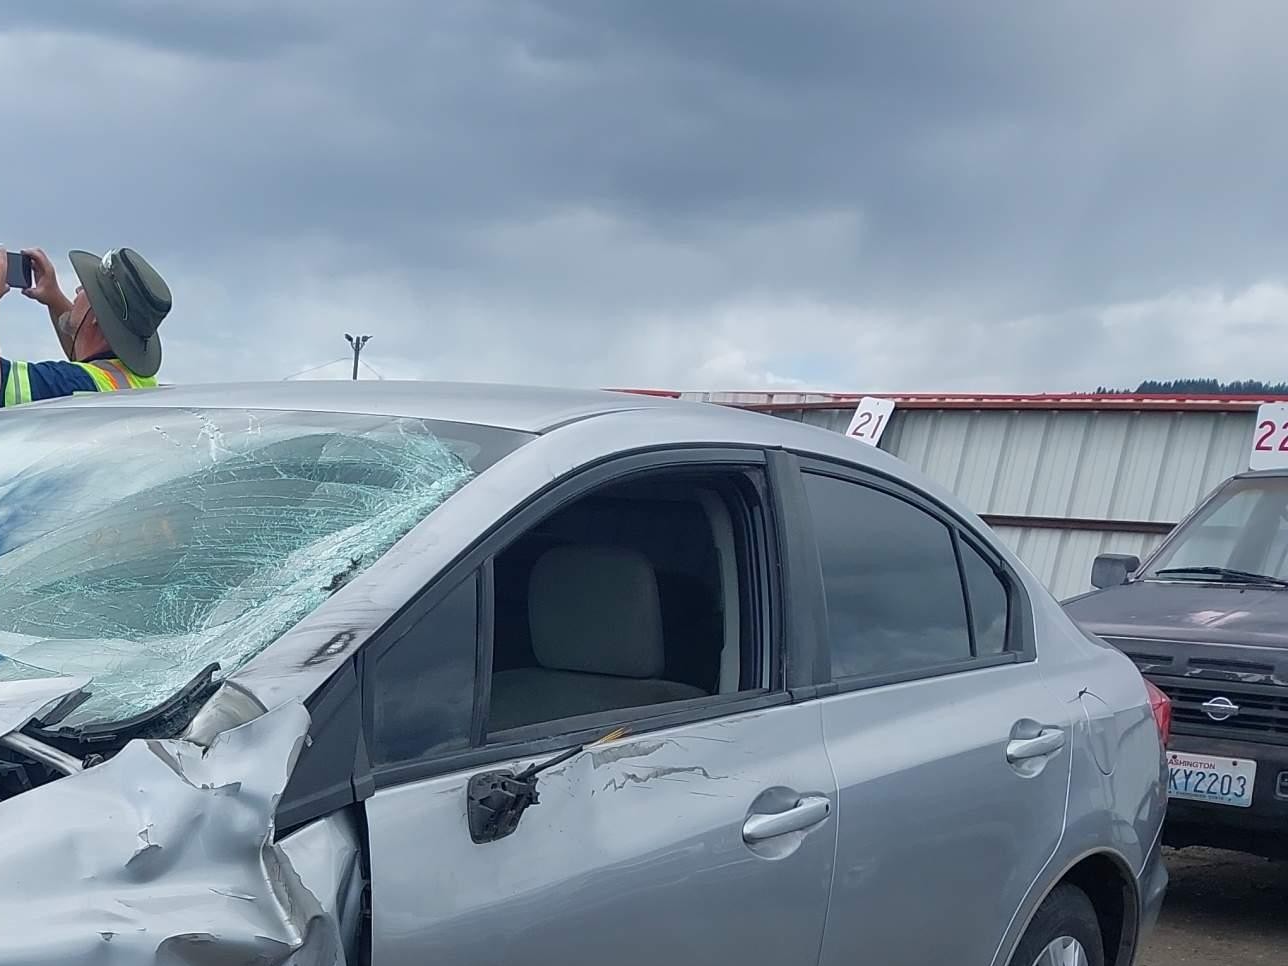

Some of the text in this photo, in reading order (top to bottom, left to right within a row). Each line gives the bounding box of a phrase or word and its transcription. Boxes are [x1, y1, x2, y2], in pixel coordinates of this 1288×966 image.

[852, 411, 884, 439] 21
[1255, 420, 1288, 451] 22
[1167, 758, 1216, 770] ASHINGTON
[1168, 767, 1247, 798] KY2203
